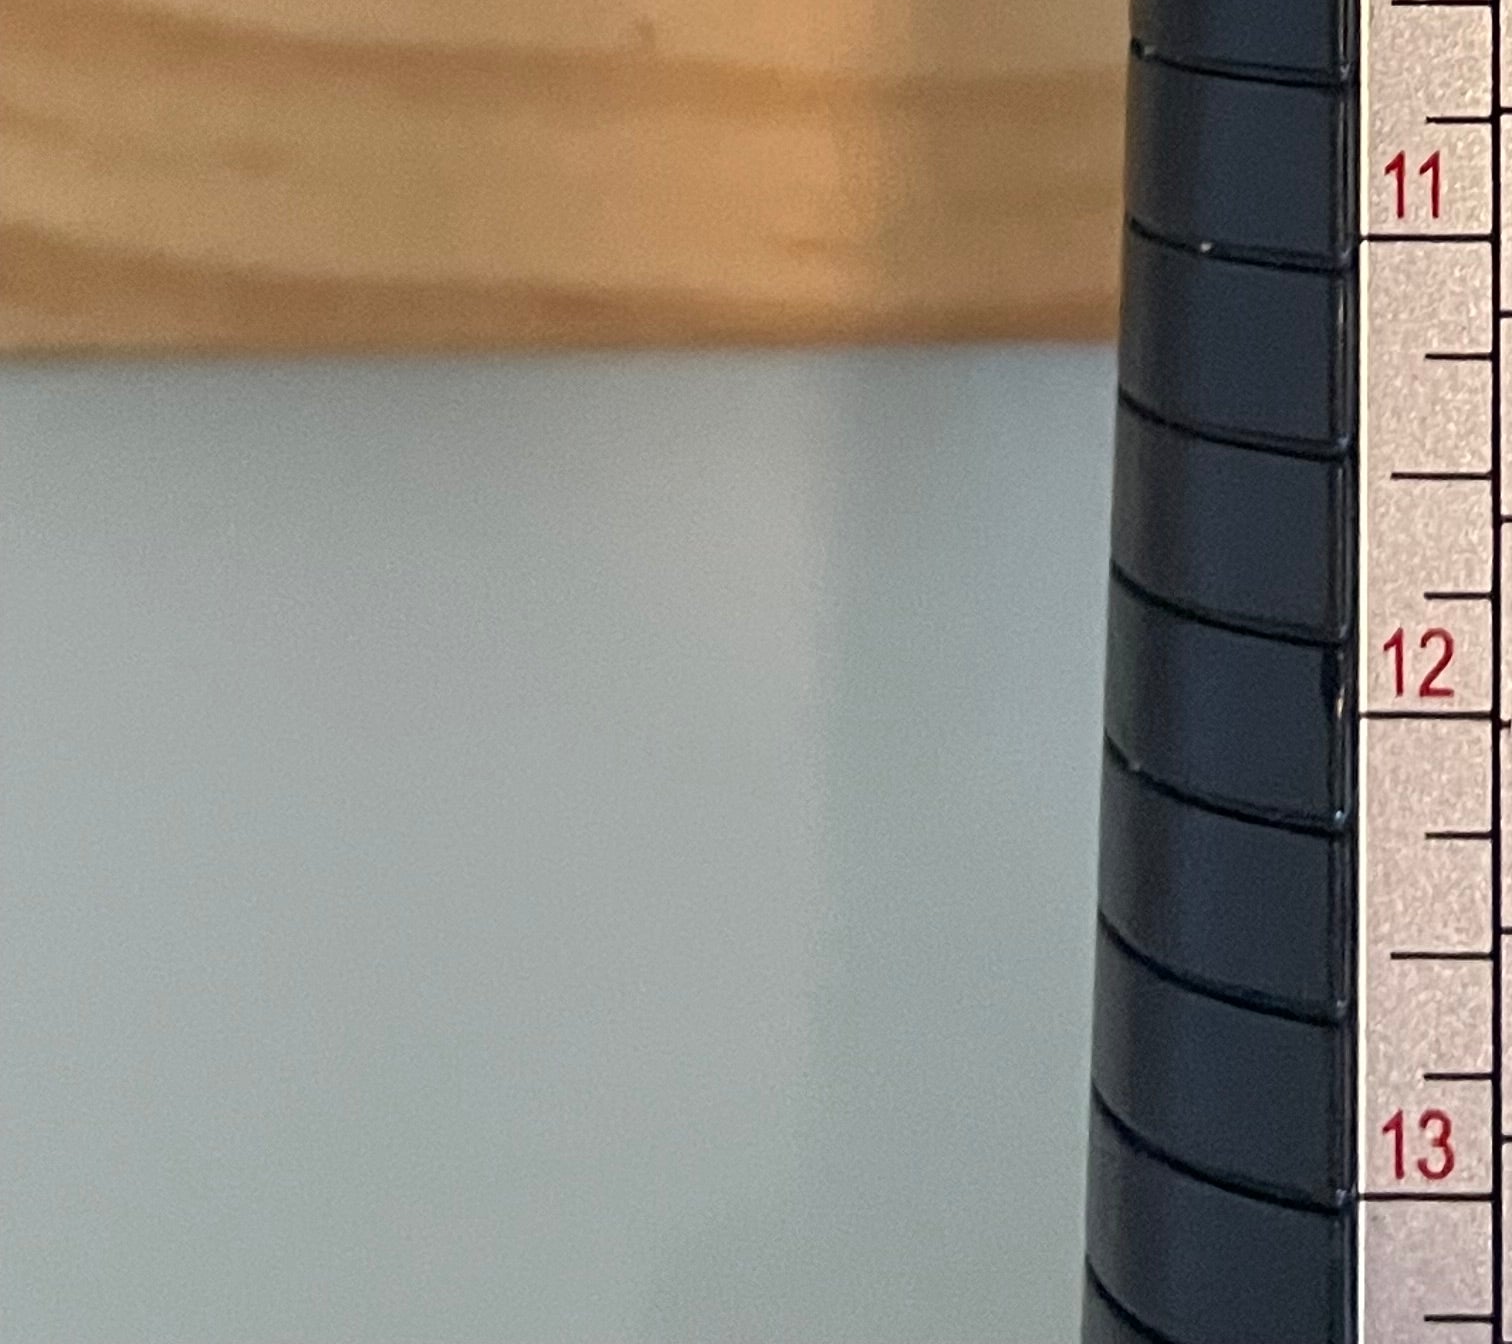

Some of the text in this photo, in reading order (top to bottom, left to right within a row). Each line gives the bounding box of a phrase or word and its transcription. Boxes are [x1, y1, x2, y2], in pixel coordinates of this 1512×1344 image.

[1382, 149, 1444, 221] 11
[1381, 625, 1458, 700] 12
[1379, 1107, 1458, 1182] 13
